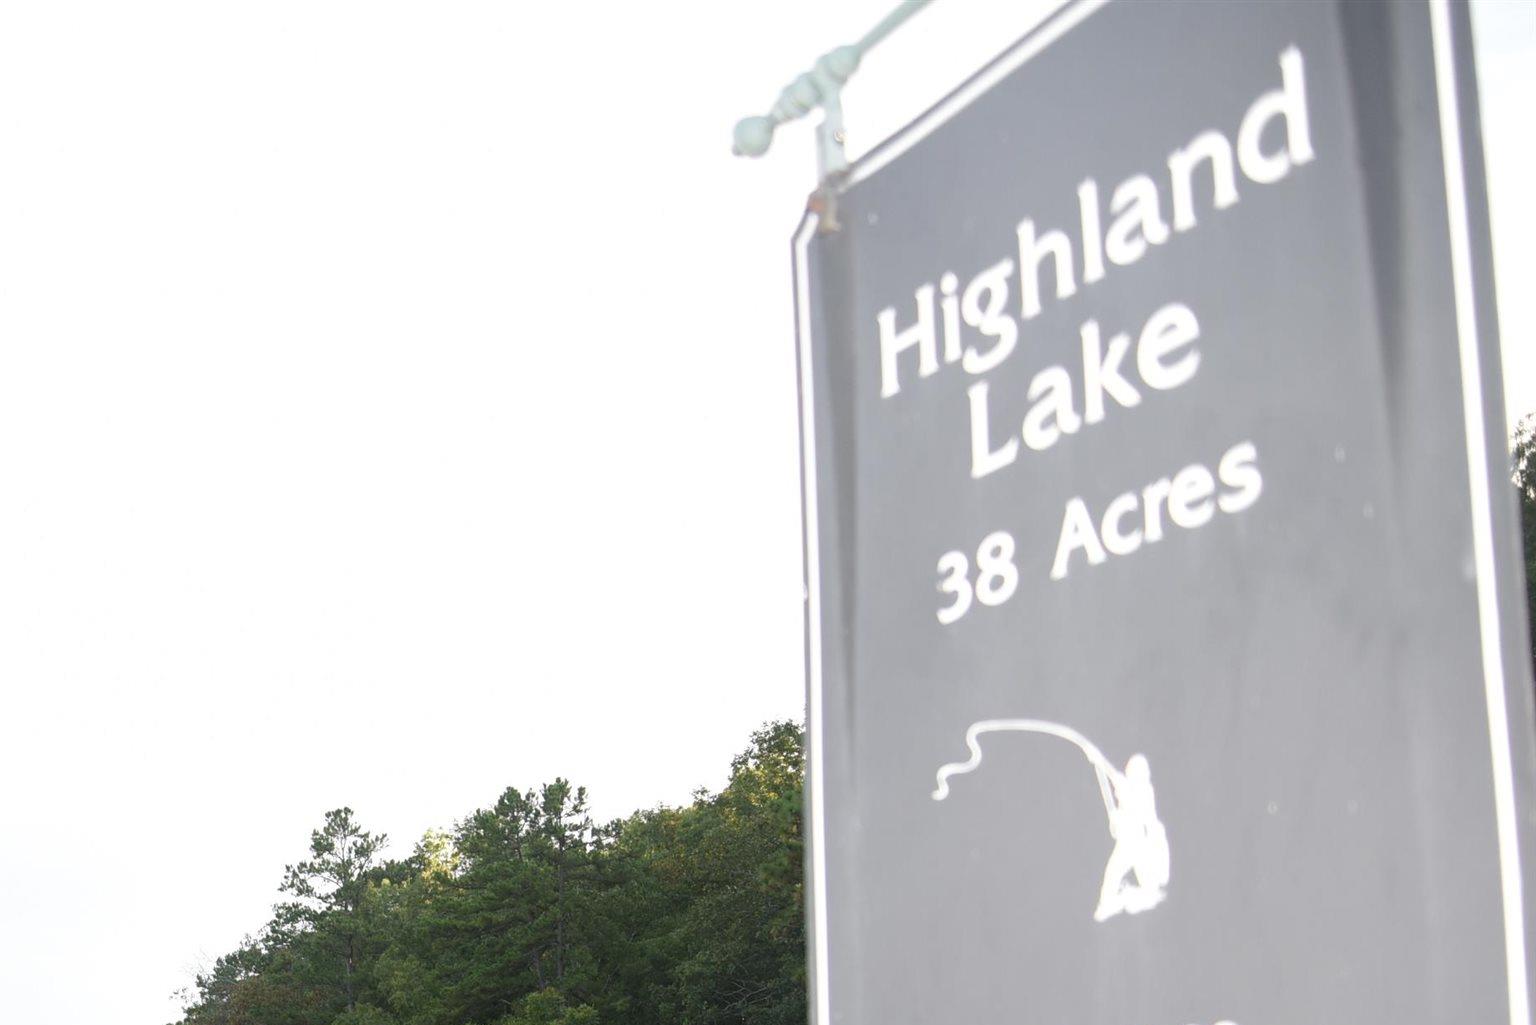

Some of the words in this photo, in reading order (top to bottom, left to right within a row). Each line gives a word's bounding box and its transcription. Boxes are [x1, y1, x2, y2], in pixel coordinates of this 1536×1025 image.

[877, 43, 1314, 399] Highland
[967, 303, 1201, 479] Lake
[936, 531, 1019, 626] 38
[1050, 441, 1263, 580] Acres
